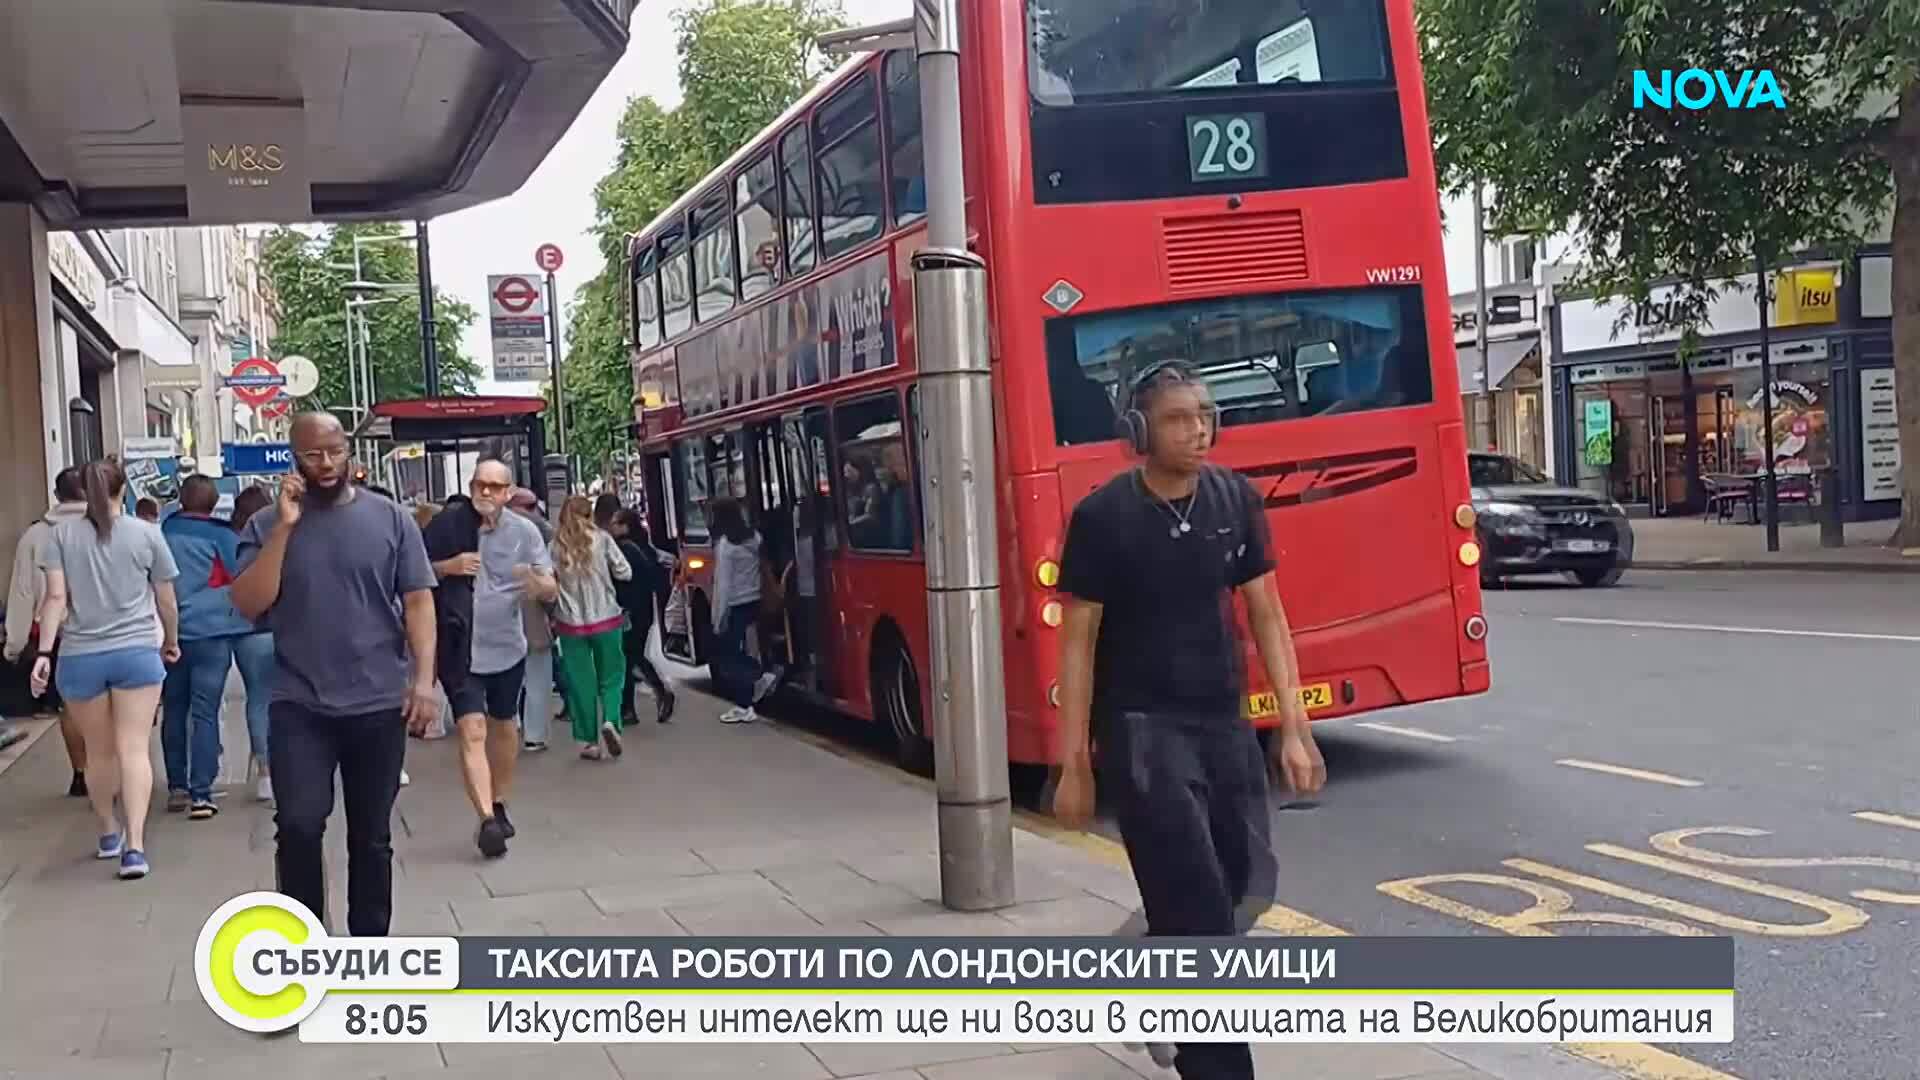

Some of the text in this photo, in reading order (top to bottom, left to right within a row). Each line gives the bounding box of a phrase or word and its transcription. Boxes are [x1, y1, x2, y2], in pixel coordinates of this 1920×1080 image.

[207, 143, 285, 171] M&S
[1193, 118, 1255, 173] 28
[1366, 264, 1421, 284] VW1291
[835, 277, 890, 336] Which?
[1801, 286, 1831, 307] itsu
